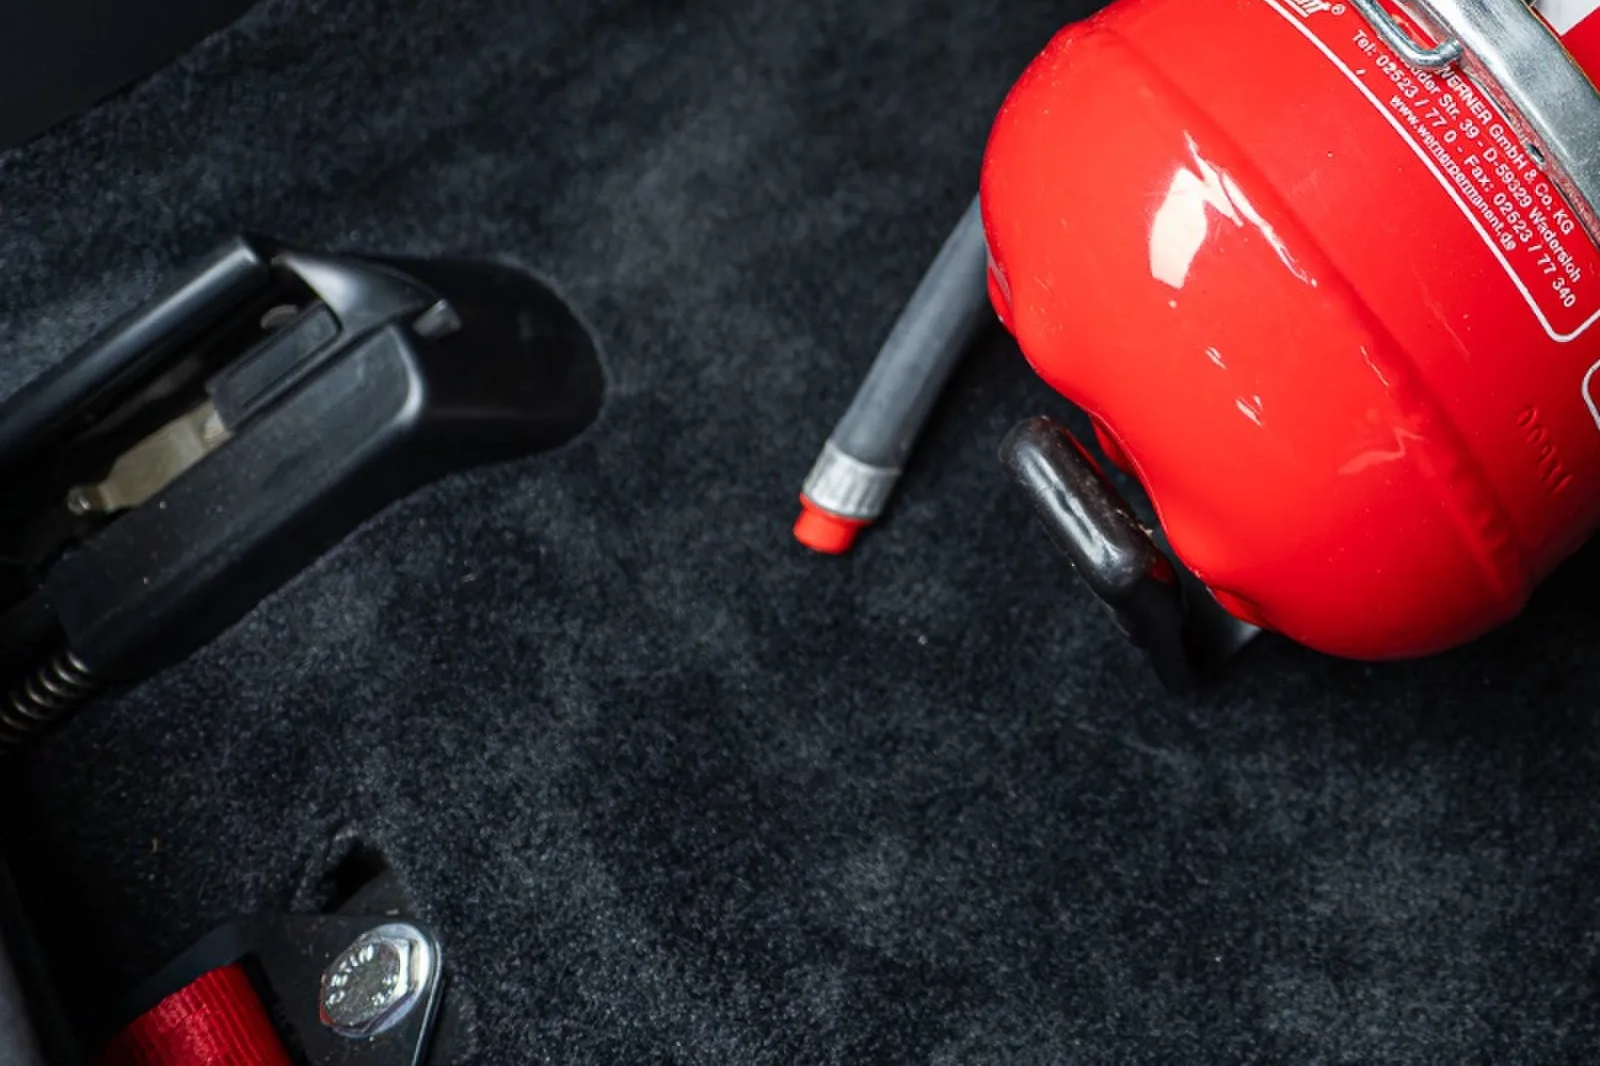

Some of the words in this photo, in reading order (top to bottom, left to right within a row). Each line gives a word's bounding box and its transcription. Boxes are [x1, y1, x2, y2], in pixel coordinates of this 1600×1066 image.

[1375, 54, 1419, 98] 02523
[1425, 107, 1448, 128] 77
[1463, 153, 1495, 192] Fax:
[1552, 278, 1577, 308] 340
[1439, 94, 1460, 120] Str.
[1459, 118, 1480, 139] 39
[1482, 146, 1533, 208] D-59329
[1529, 206, 1581, 283] Wadersloh
[1488, 123, 1527, 170] GmbH
[1523, 169, 1537, 184] &
[1535, 182, 1553, 210] Co.
[1553, 208, 1575, 234] KG
